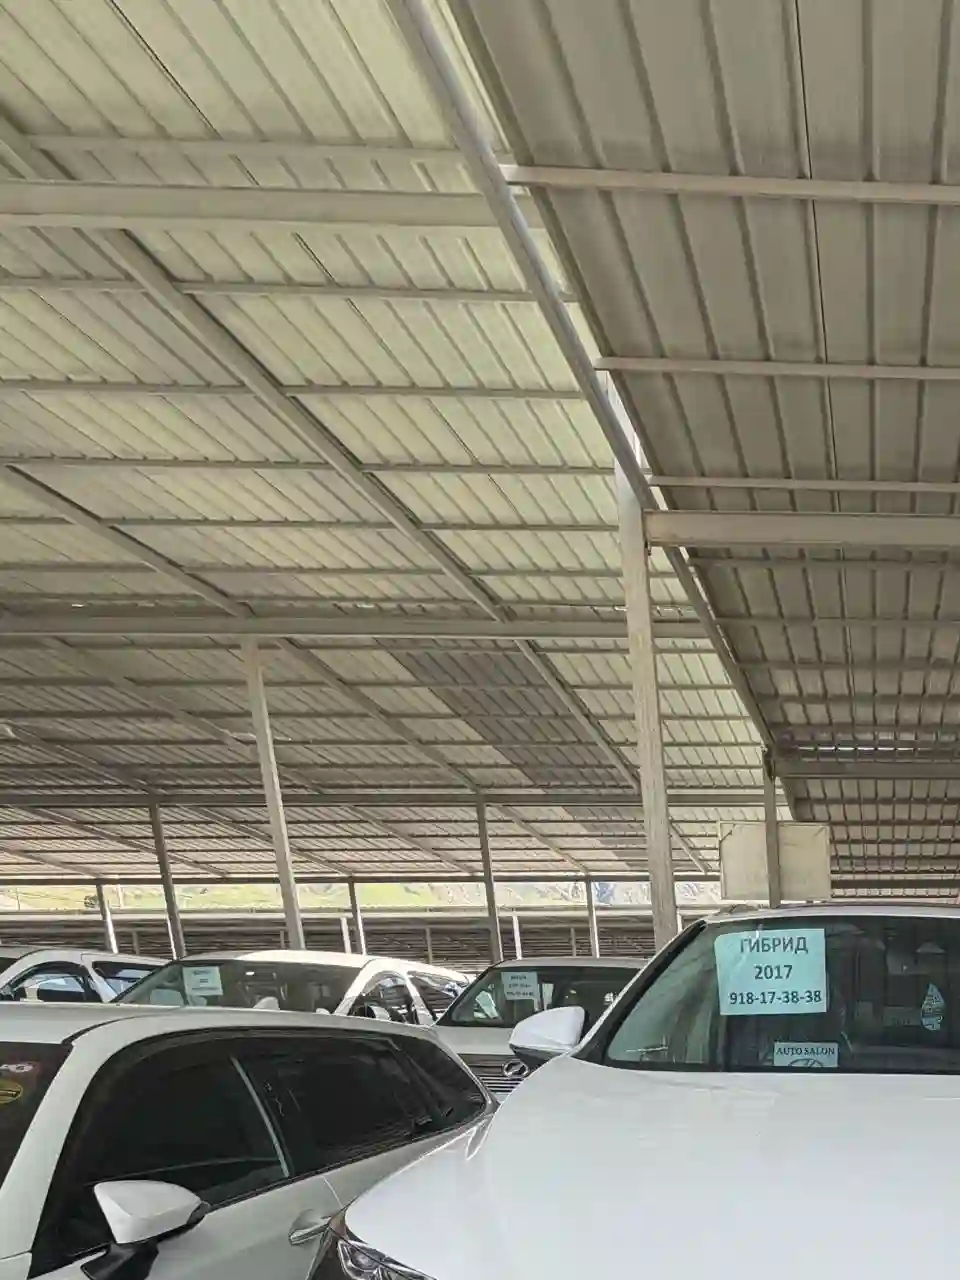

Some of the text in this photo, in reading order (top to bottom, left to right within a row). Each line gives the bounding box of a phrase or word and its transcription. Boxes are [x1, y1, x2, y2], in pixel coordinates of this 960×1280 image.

[740, 936, 809, 954] ГИБРИД
[754, 964, 793, 980] 2017
[729, 990, 822, 1005] 918-17-38-38
[776, 1047, 835, 1056] AUTO SALON
